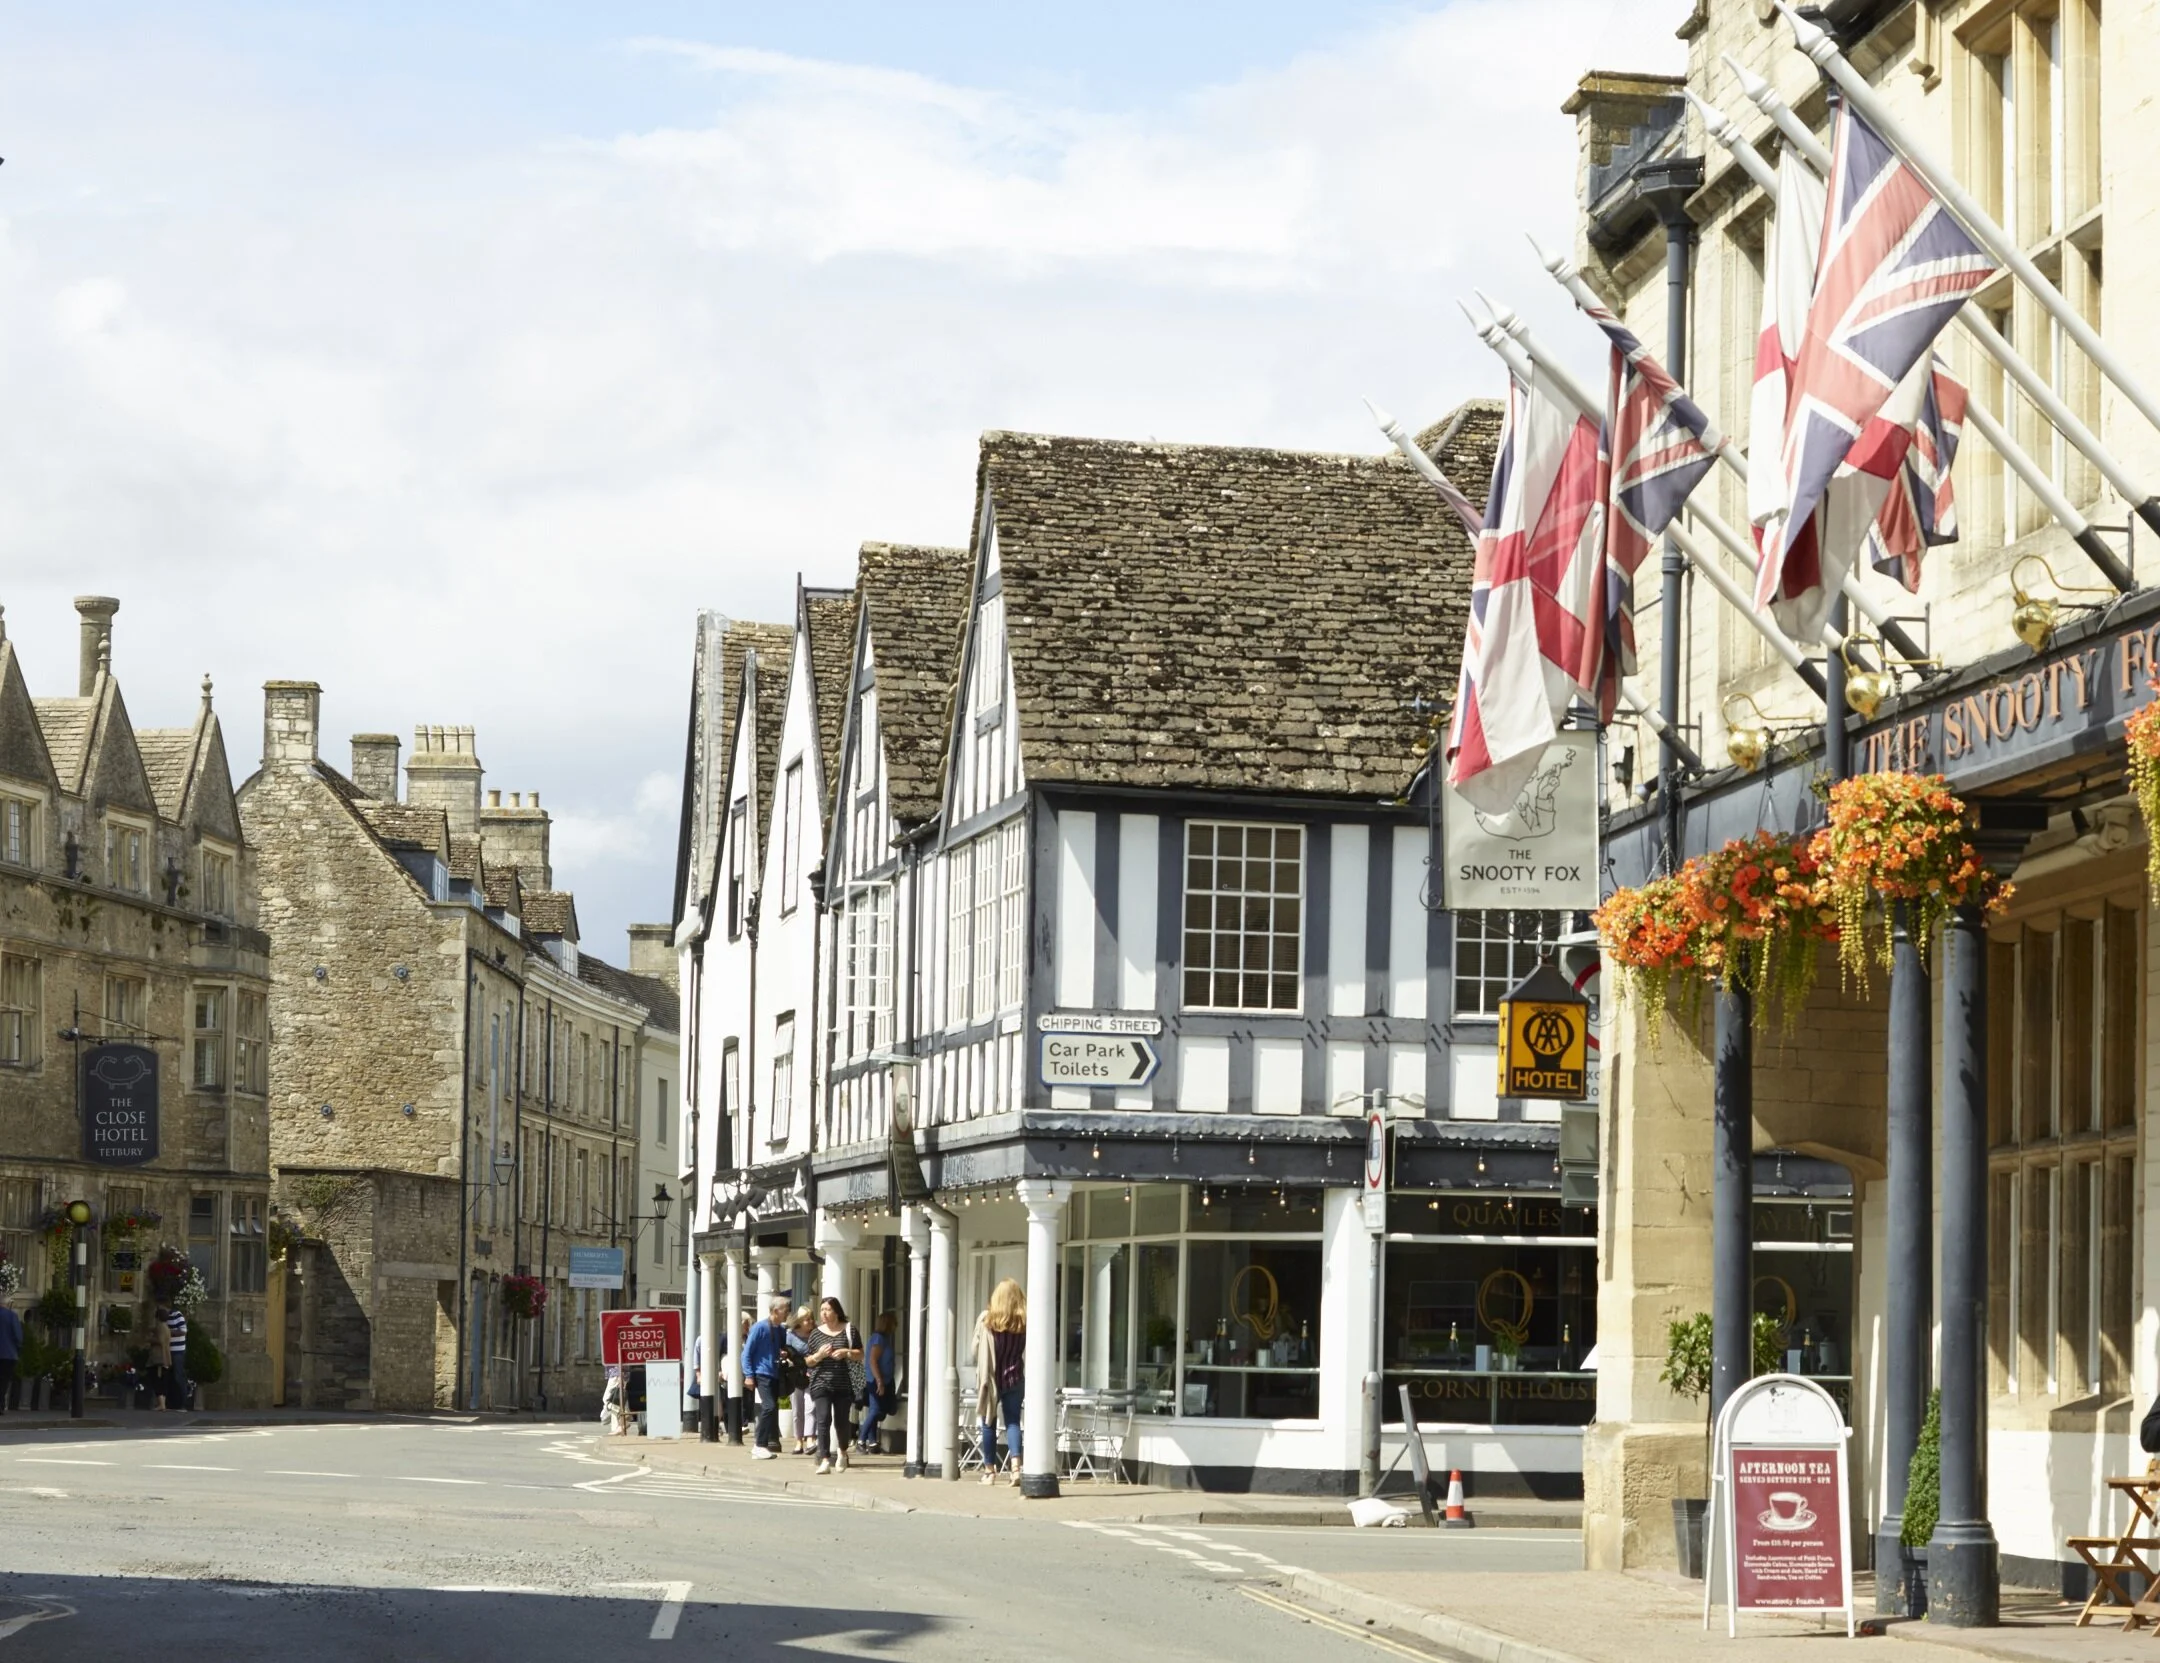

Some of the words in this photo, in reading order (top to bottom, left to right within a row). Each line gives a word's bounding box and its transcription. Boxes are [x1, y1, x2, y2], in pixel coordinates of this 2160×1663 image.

[1943, 648, 2097, 756] SNOOTY
[1508, 849, 1532, 860] THE
[1460, 865, 1536, 881] SNOOTY
[1545, 866, 1581, 881] FOX
[1042, 1017, 1102, 1030] CHIPPING
[1110, 1019, 1158, 1032] STREET
[1049, 1042, 1080, 1057] Car
[1086, 1043, 1125, 1058] Park
[1050, 1061, 1109, 1077] Toilets
[1515, 1071, 1578, 1090] HOTEL
[109, 1098, 132, 1107] THE
[96, 1111, 146, 1125] CLOSE
[95, 1128, 148, 1141] HOTEL
[99, 1147, 144, 1157] TETBURY
[1453, 1202, 1562, 1227] QUAYLES
[1230, 1265, 1279, 1340] Q
[1477, 1268, 1534, 1344] Q
[620, 1330, 664, 1340] CLOSED
[622, 1341, 662, 1349] AHEAD
[627, 1351, 659, 1360] ROAD
[1740, 1462, 1806, 1474] AFTERNOON
[1809, 1462, 1831, 1474] TEA
